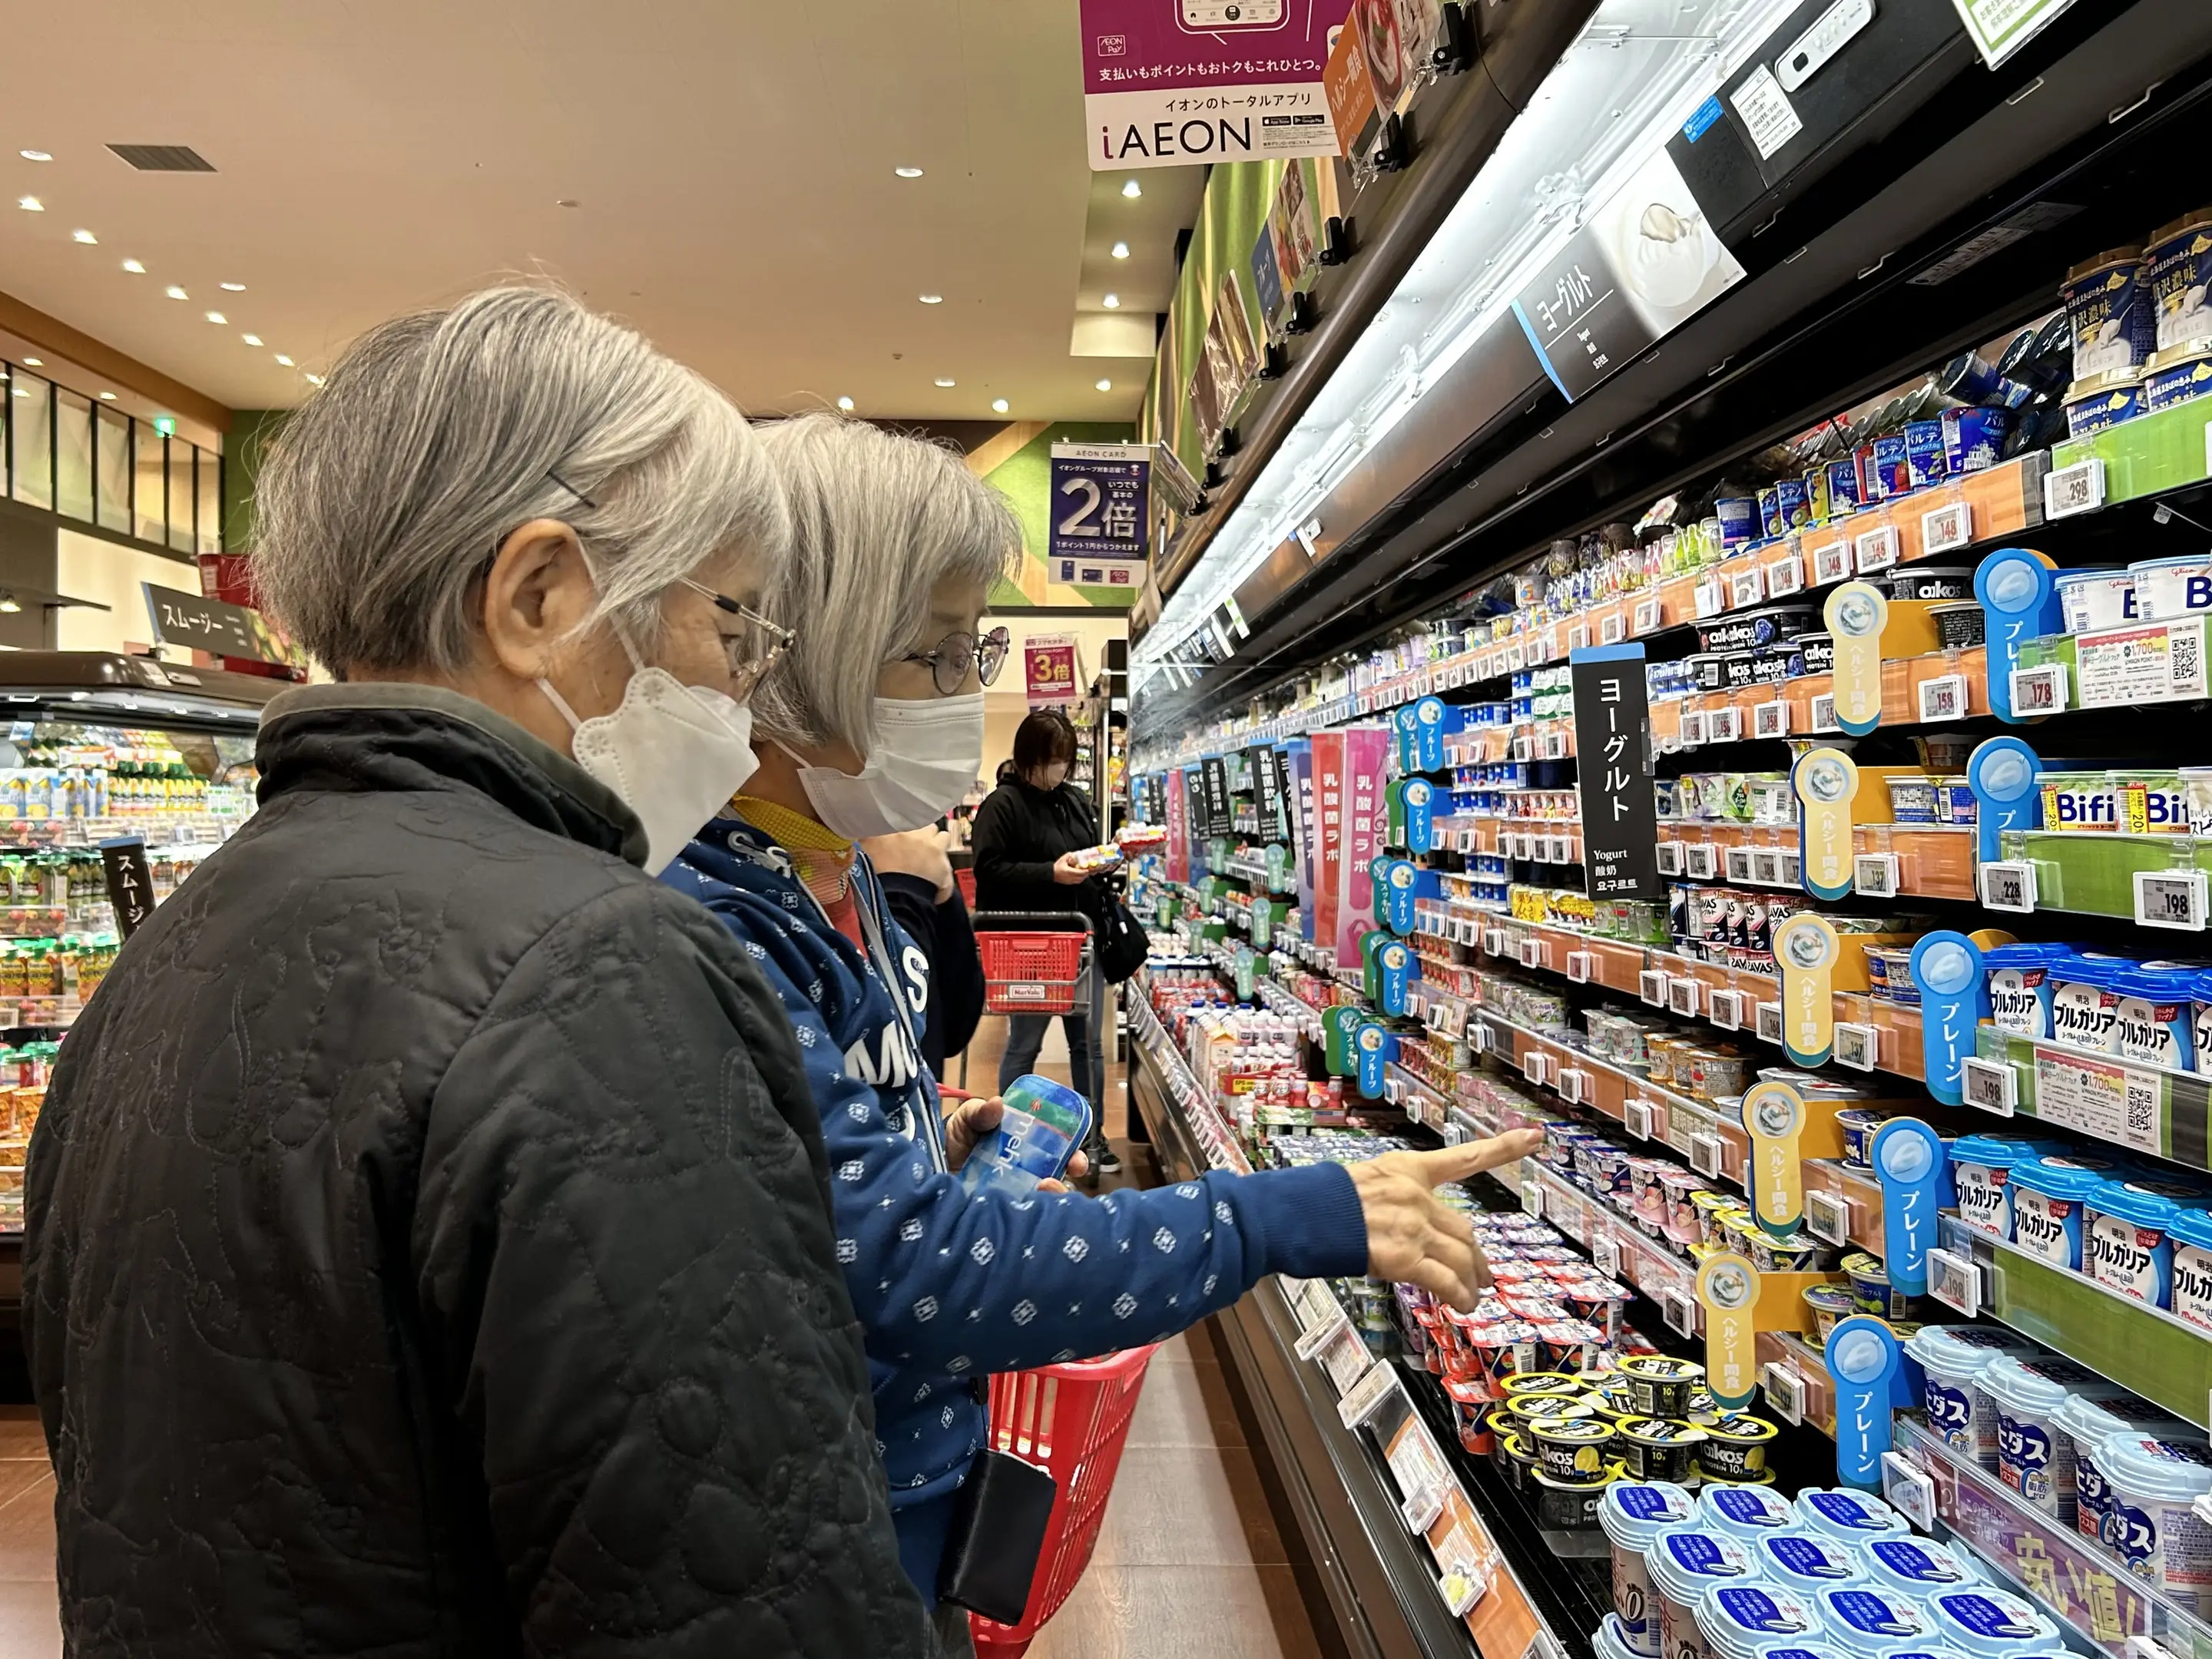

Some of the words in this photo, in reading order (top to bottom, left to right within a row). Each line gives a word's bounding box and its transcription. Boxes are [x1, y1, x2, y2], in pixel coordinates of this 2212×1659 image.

[1099, 59, 1321, 82] 支払いもポイントもおトクもこれひとつ。
[1165, 93, 1310, 112] イオンのトータルアプリ
[1102, 117, 1251, 160] iAEON
[1536, 264, 1592, 332] ヨーグルト
[1108, 481, 1139, 489] いつでも
[2069, 480, 2088, 501] 298
[1059, 478, 1101, 537] 2
[1101, 500, 1137, 538] 倍
[1940, 518, 1957, 538] 148
[2171, 568, 2197, 577] Glico
[161, 603, 224, 634] スムージー
[1035, 654, 1052, 681] 3
[1054, 664, 1071, 681] 倍
[1849, 644, 1866, 716] ヘルシー間食
[1937, 692, 1954, 710] 158
[2032, 682, 2051, 705] 178
[1426, 727, 1436, 763] フルーツ
[1600, 678, 1631, 822] ヨーグルト
[1323, 773, 1339, 862] 乳酸菌ラボ
[1354, 774, 1373, 874] 乳酸菌ラボ
[1416, 809, 1426, 845] フルーツ
[1593, 849, 1628, 863] Yogurt
[1821, 811, 1839, 881] ヘルシー間食
[1594, 864, 1617, 878] 酸奶
[1596, 879, 1638, 892] 요구르트
[117, 854, 146, 929] スムージ
[2003, 881, 2021, 899] 228
[2164, 893, 2189, 915] 198
[1398, 891, 1408, 926] フルーツ
[1391, 972, 1399, 1008] フルーツ
[2005, 979, 2016, 989] 明治
[2075, 994, 2090, 1005] 明治
[1799, 976, 1818, 1048] ヘルシー間食
[2054, 1004, 2116, 1035] ブルガリア
[2133, 1008, 2147, 1020] 明治
[1940, 1002, 1962, 1083] プレーン
[2061, 1031, 2077, 1041] ヨーグルト
[2091, 1037, 2106, 1046] プレーン
[2118, 1018, 2170, 1051] ブルガリア
[1983, 1081, 2002, 1103] 198
[1769, 1145, 1787, 1217] ヘルシー間食
[1970, 1173, 1982, 1183] 明治
[1957, 1181, 2002, 1210] ブルガリア
[2028, 1200, 2040, 1211] 明治
[1901, 1190, 1922, 1271] プレーン
[2015, 1207, 2062, 1243] ブルガリア
[2111, 1227, 2126, 1240] 明治
[2091, 1236, 2151, 1273] ブルガリア
[1721, 1316, 1740, 1389] ヘルシー間食
[1854, 1391, 1875, 1473] プレーン
